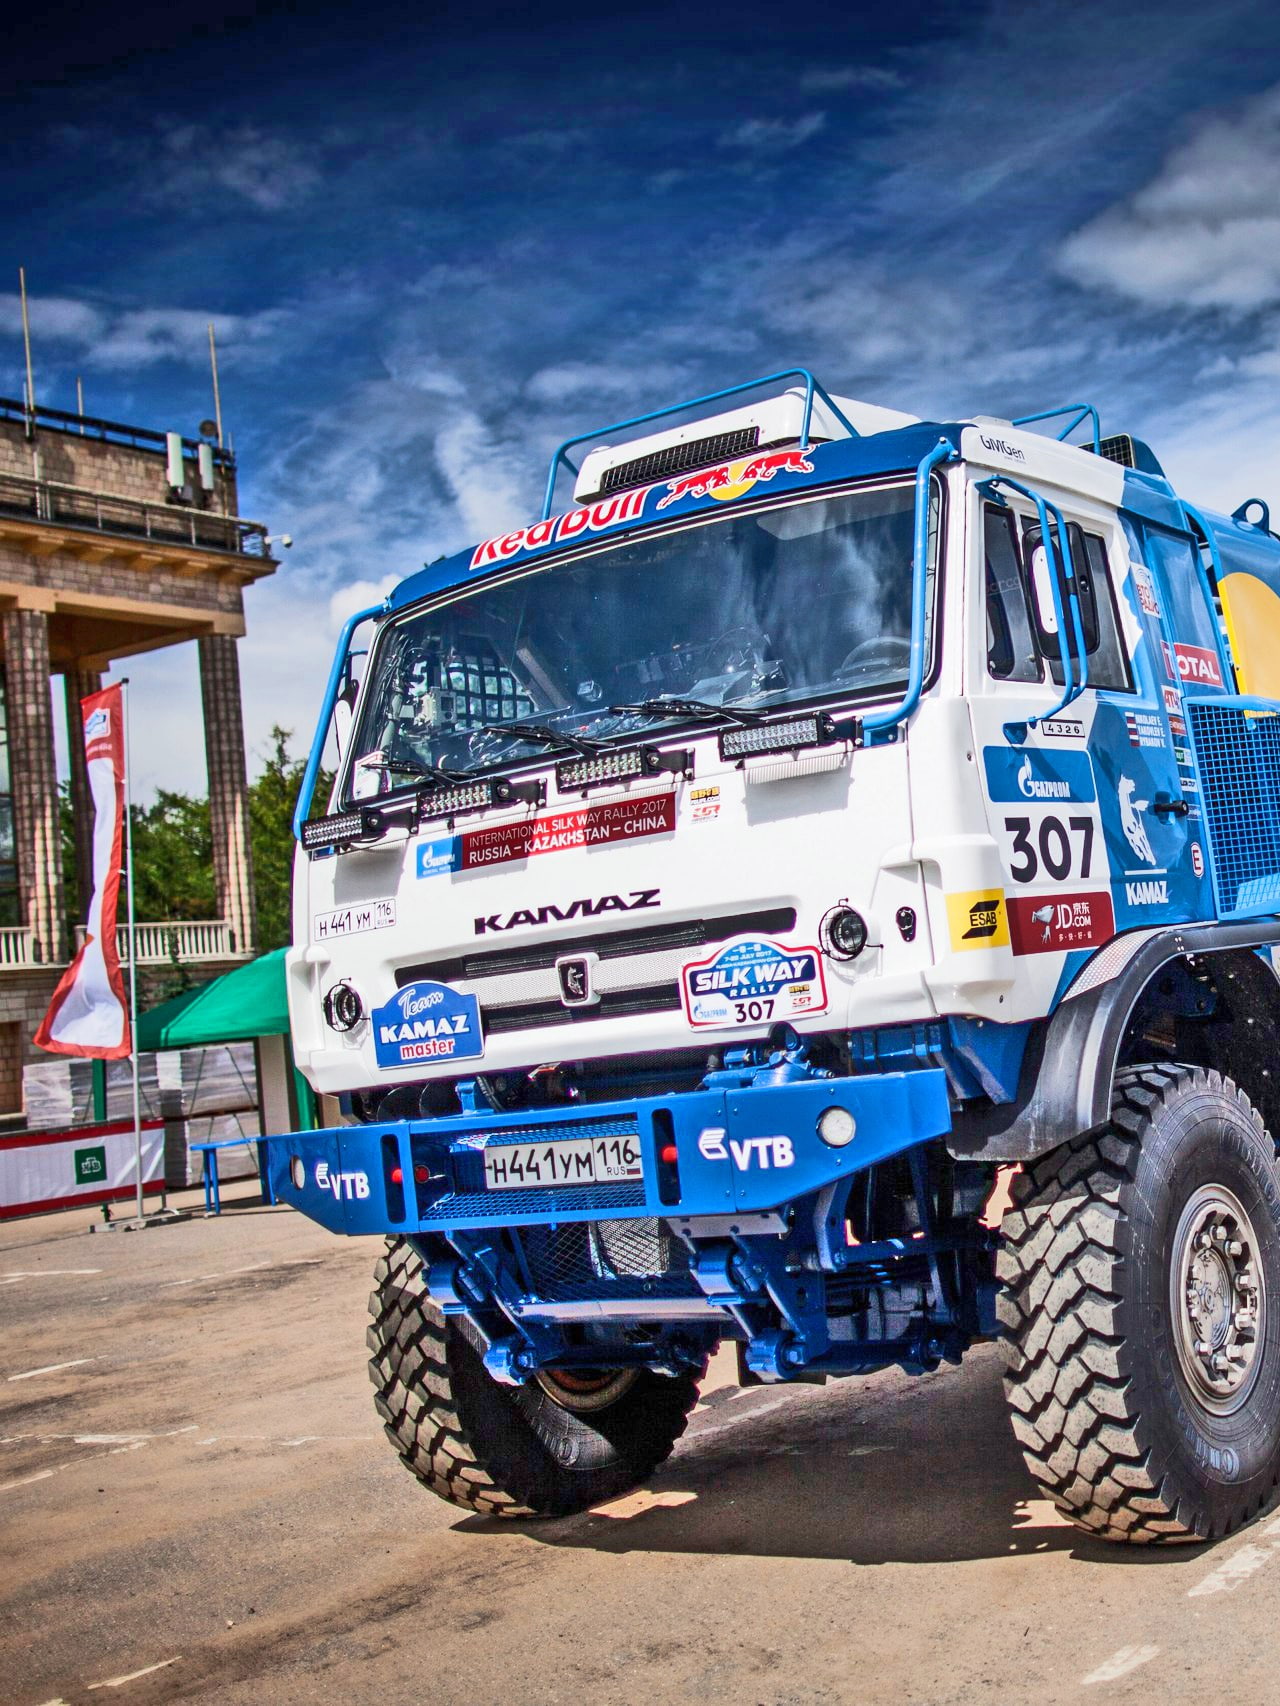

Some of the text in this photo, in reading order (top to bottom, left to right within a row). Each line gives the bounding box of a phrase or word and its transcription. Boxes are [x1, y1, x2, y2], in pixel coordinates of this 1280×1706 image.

[472, 489, 651, 567] Red Bull
[1164, 648, 1220, 680] TOTAL
[1048, 724, 1080, 734] 4326
[1035, 781, 1071, 797] GAZPROM
[469, 798, 667, 847] INTERNATIONAL SILK WAY RALLY 2017
[469, 814, 667, 864] RUSSIA KAZAKHSTAN CHINA
[1005, 815, 1094, 883] 307
[1125, 880, 1169, 905] KAMAZ
[331, 911, 351, 934] 441
[377, 903, 392, 917] 116
[473, 888, 661, 935] KAMAZ
[970, 913, 997, 927] ESAB
[696, 958, 808, 992] SILK WAY
[730, 983, 777, 997] RALLY
[398, 989, 444, 1019] Team
[734, 1000, 775, 1023] 307
[380, 1014, 470, 1044] KAMAZ
[401, 1039, 456, 1060] master
[596, 1139, 636, 1166] 116
[730, 1134, 796, 1172] VTB
[330, 1171, 371, 1200] VTB
[607, 1166, 627, 1176] RUS
